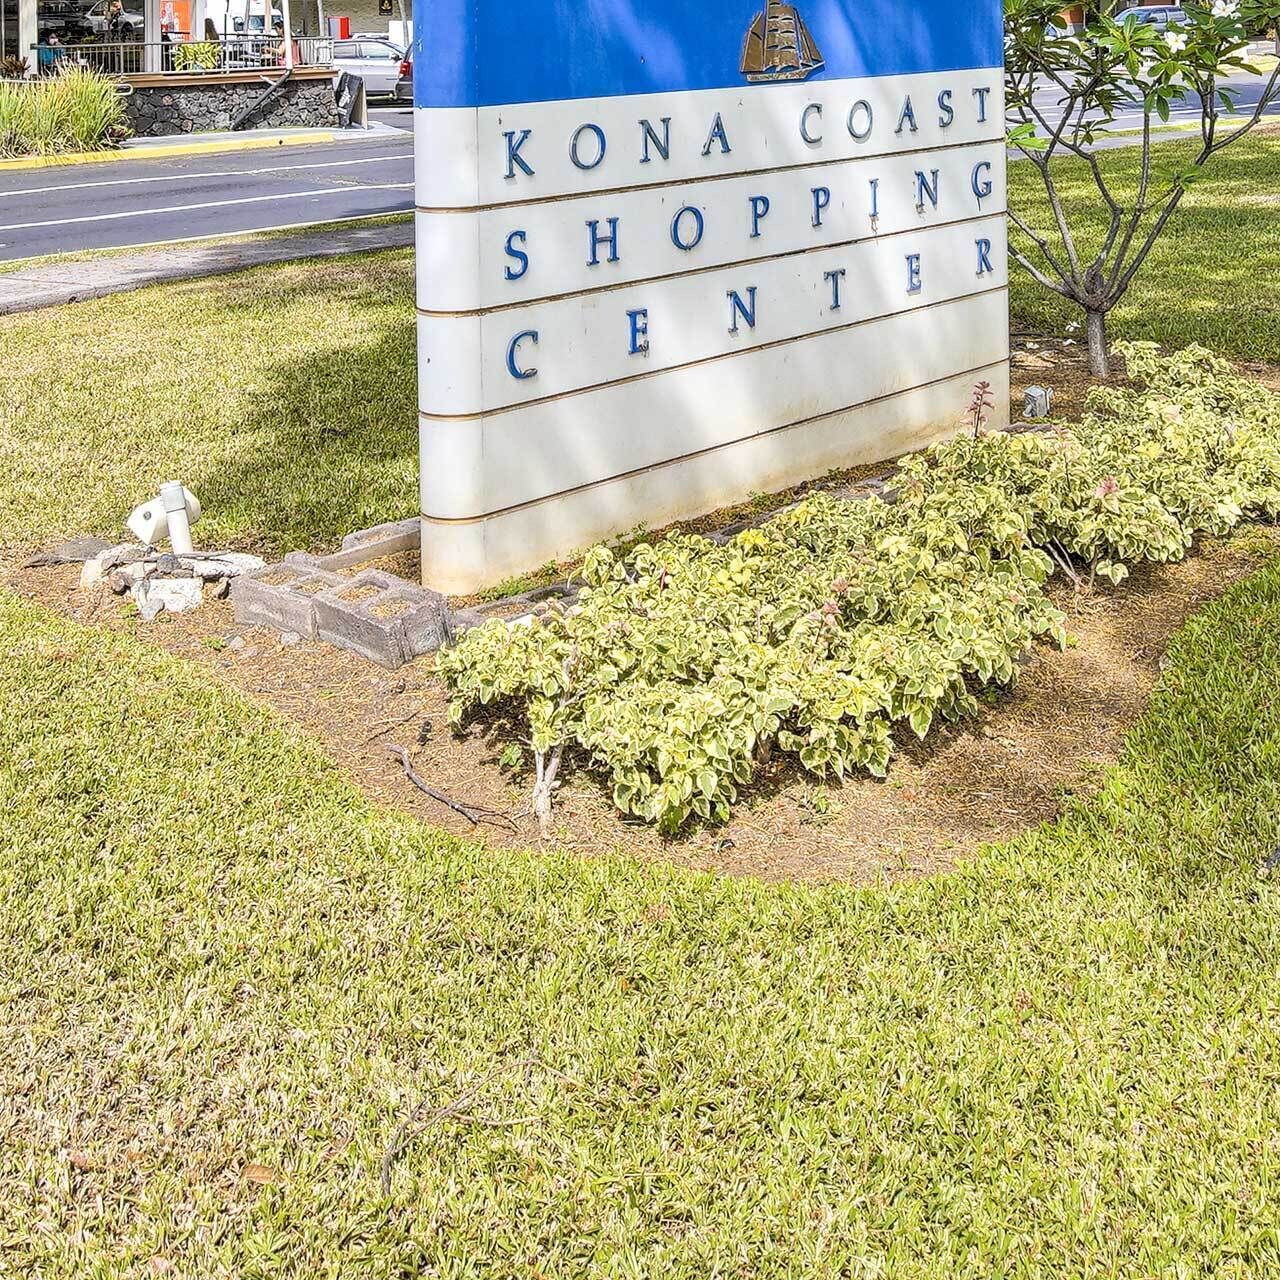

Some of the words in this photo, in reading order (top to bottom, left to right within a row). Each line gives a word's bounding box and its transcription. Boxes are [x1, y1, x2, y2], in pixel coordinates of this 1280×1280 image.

[501, 111, 733, 179] KONA
[799, 87, 991, 144] COAST
[504, 161, 993, 281] SHOPPING
[505, 238, 994, 380] CENTER
